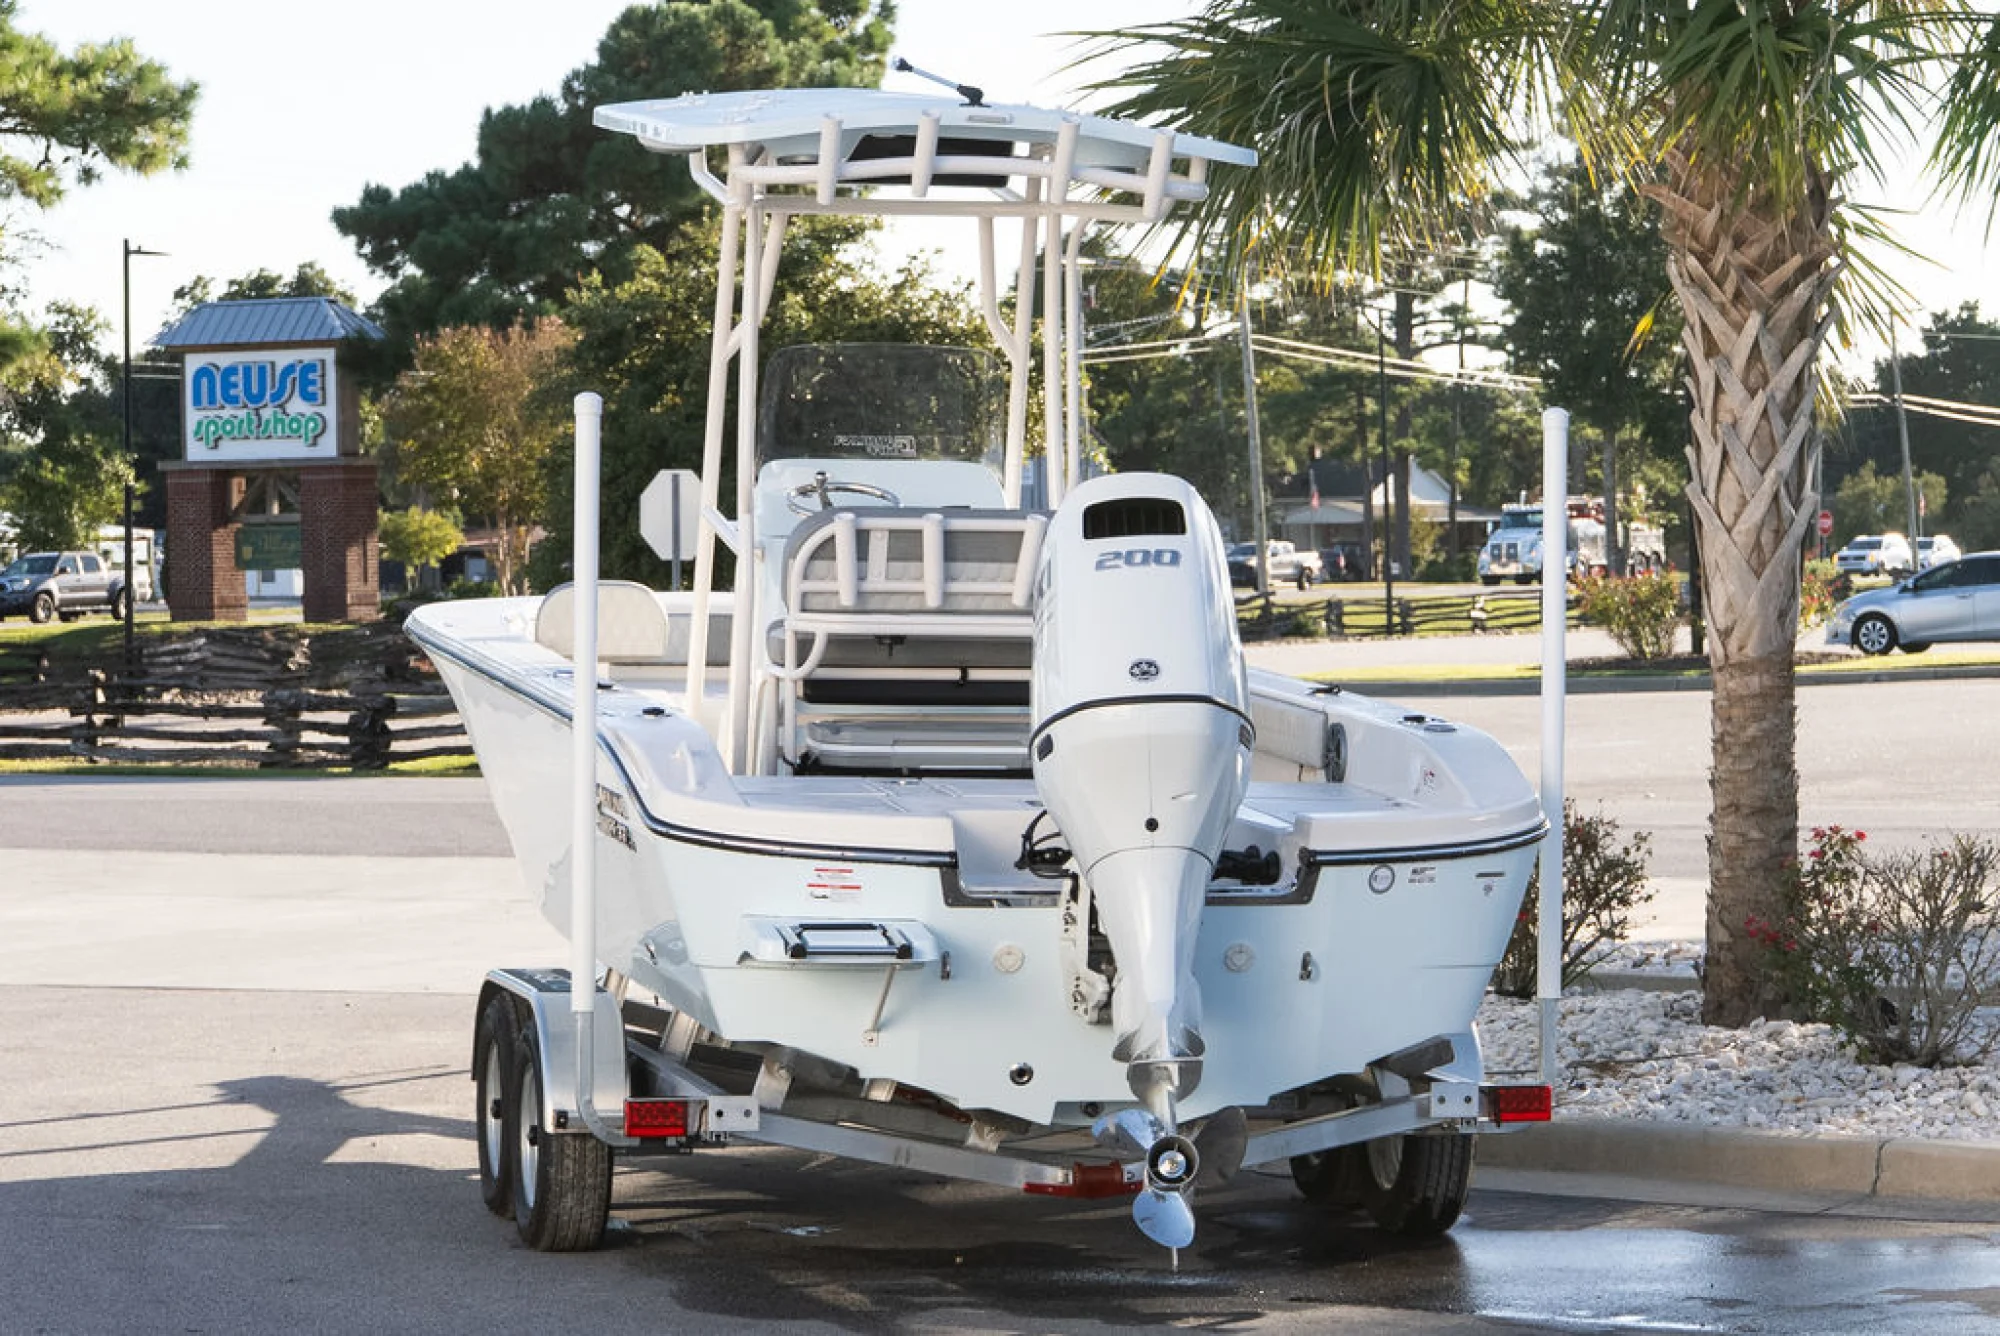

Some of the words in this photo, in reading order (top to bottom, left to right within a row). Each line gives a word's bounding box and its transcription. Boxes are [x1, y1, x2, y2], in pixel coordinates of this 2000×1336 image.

[192, 361, 322, 408] NEUSE
[193, 410, 256, 447] sport
[260, 409, 322, 446] shop
[1094, 548, 1181, 572] 200
